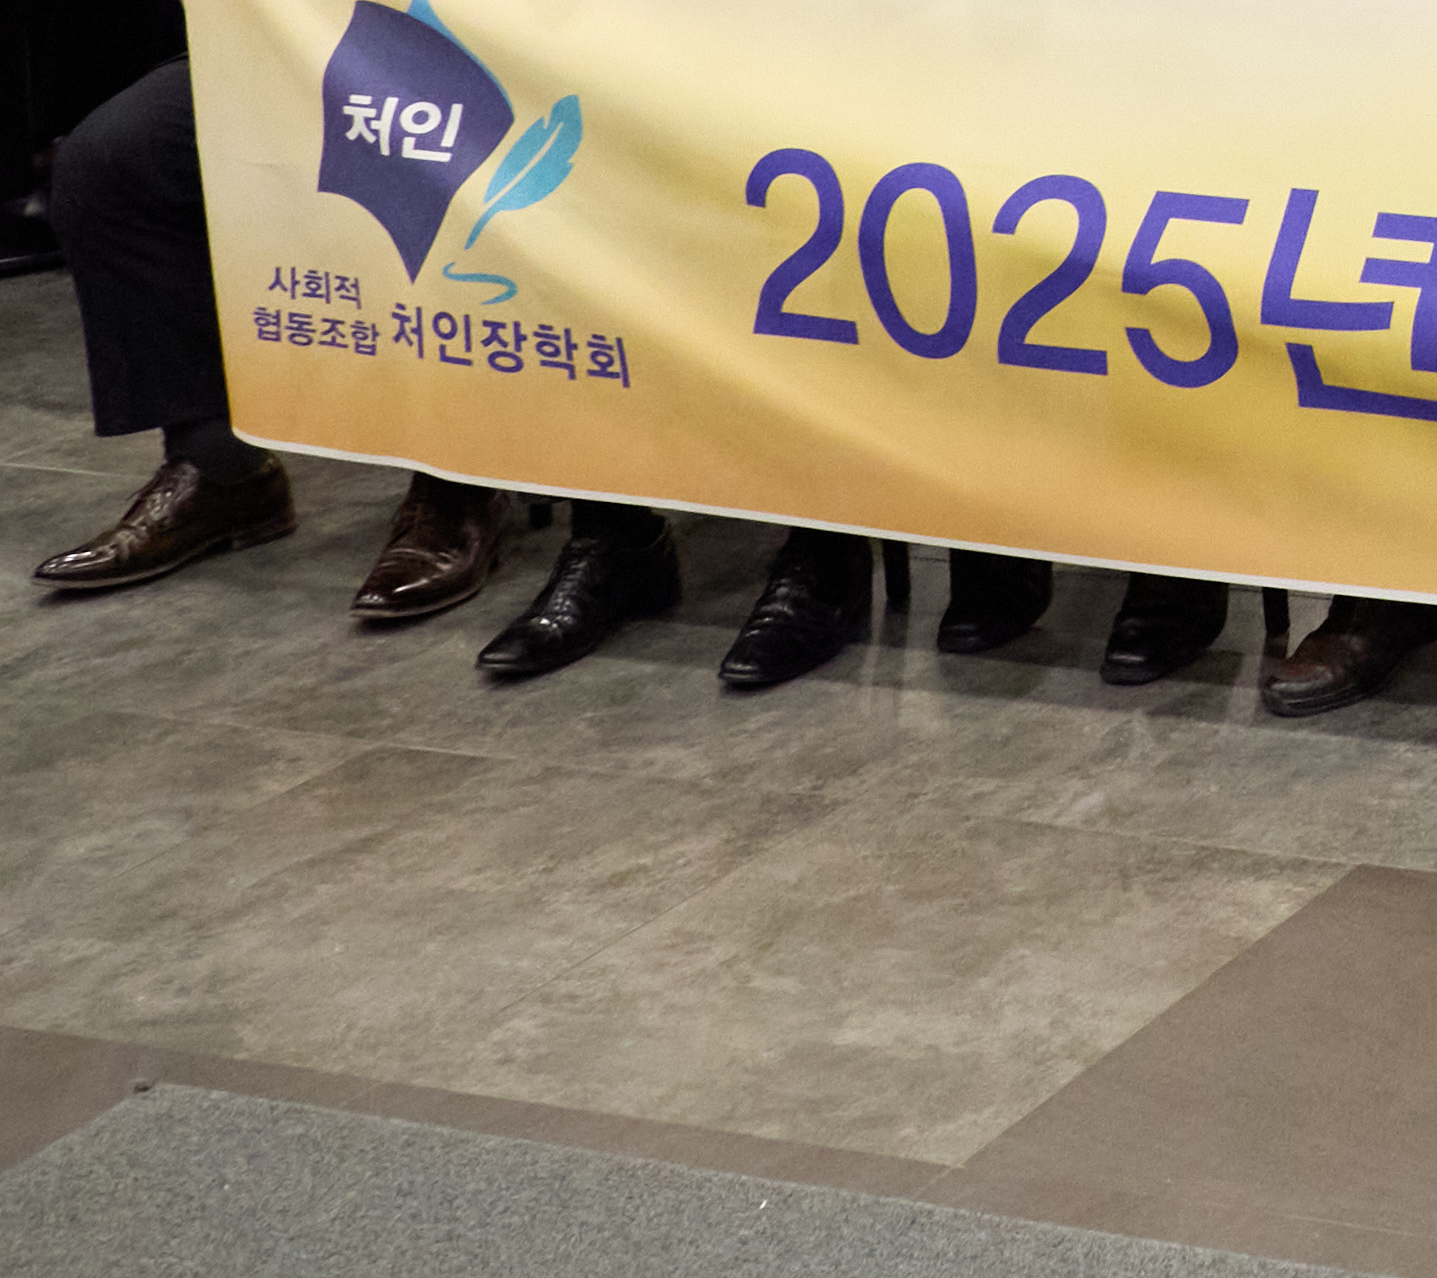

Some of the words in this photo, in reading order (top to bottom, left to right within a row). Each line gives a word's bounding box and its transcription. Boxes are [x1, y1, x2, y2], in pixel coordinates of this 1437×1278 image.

[343, 94, 462, 163] 처인
[268, 267, 361, 309] 사회적
[253, 306, 379, 357] 협동조합
[391, 303, 631, 388] 처인장학회
